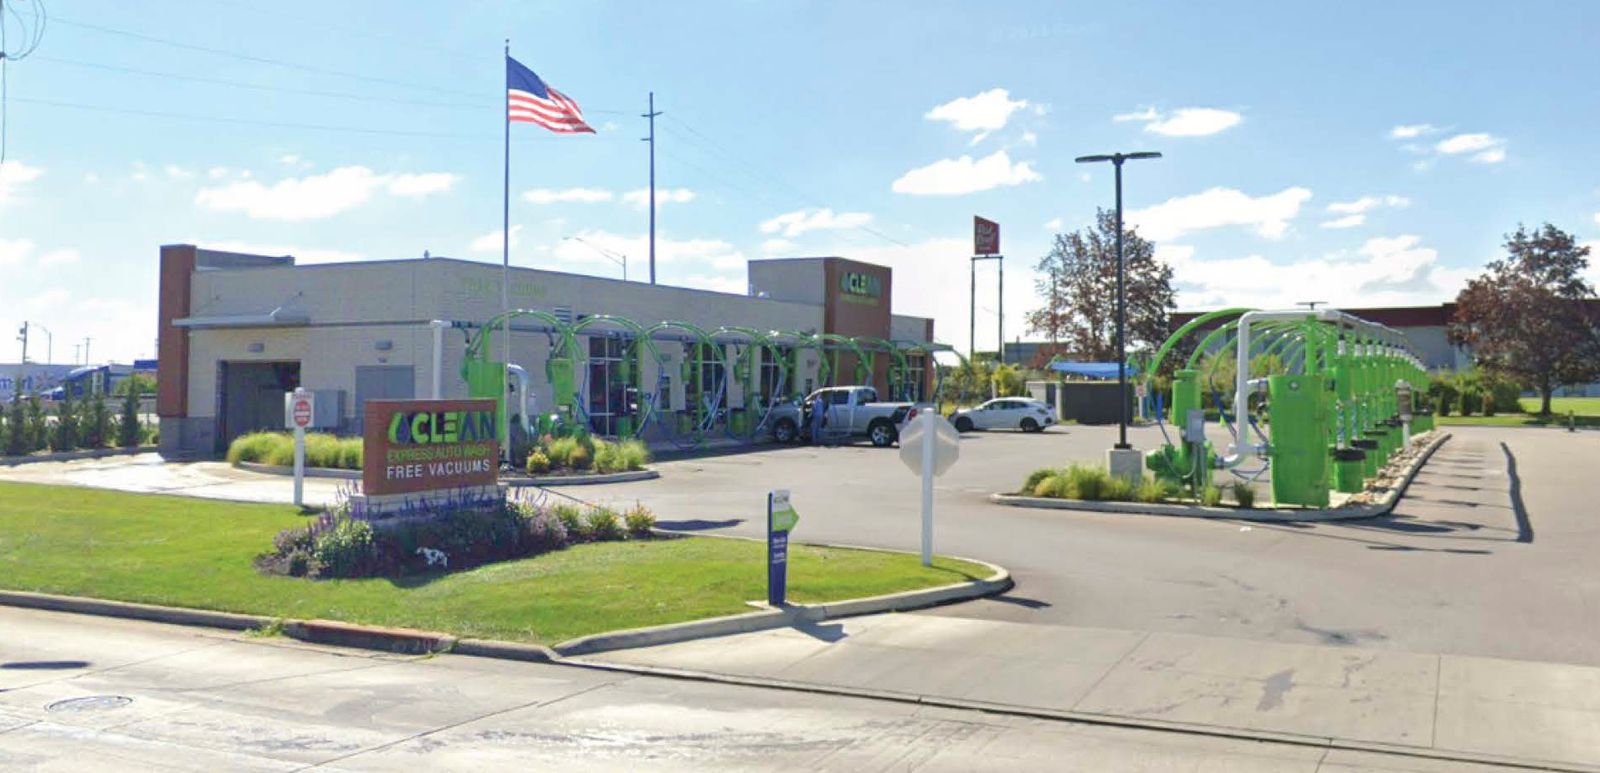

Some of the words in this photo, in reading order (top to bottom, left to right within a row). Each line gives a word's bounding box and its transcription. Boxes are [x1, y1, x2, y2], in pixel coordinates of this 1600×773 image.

[411, 411, 496, 444] CLEAN
[387, 447, 434, 462] EXPRESS
[435, 446, 460, 458] AUTO
[462, 443, 492, 457] WASH
[386, 463, 425, 480] FREE
[428, 458, 491, 477] VACUUMS
